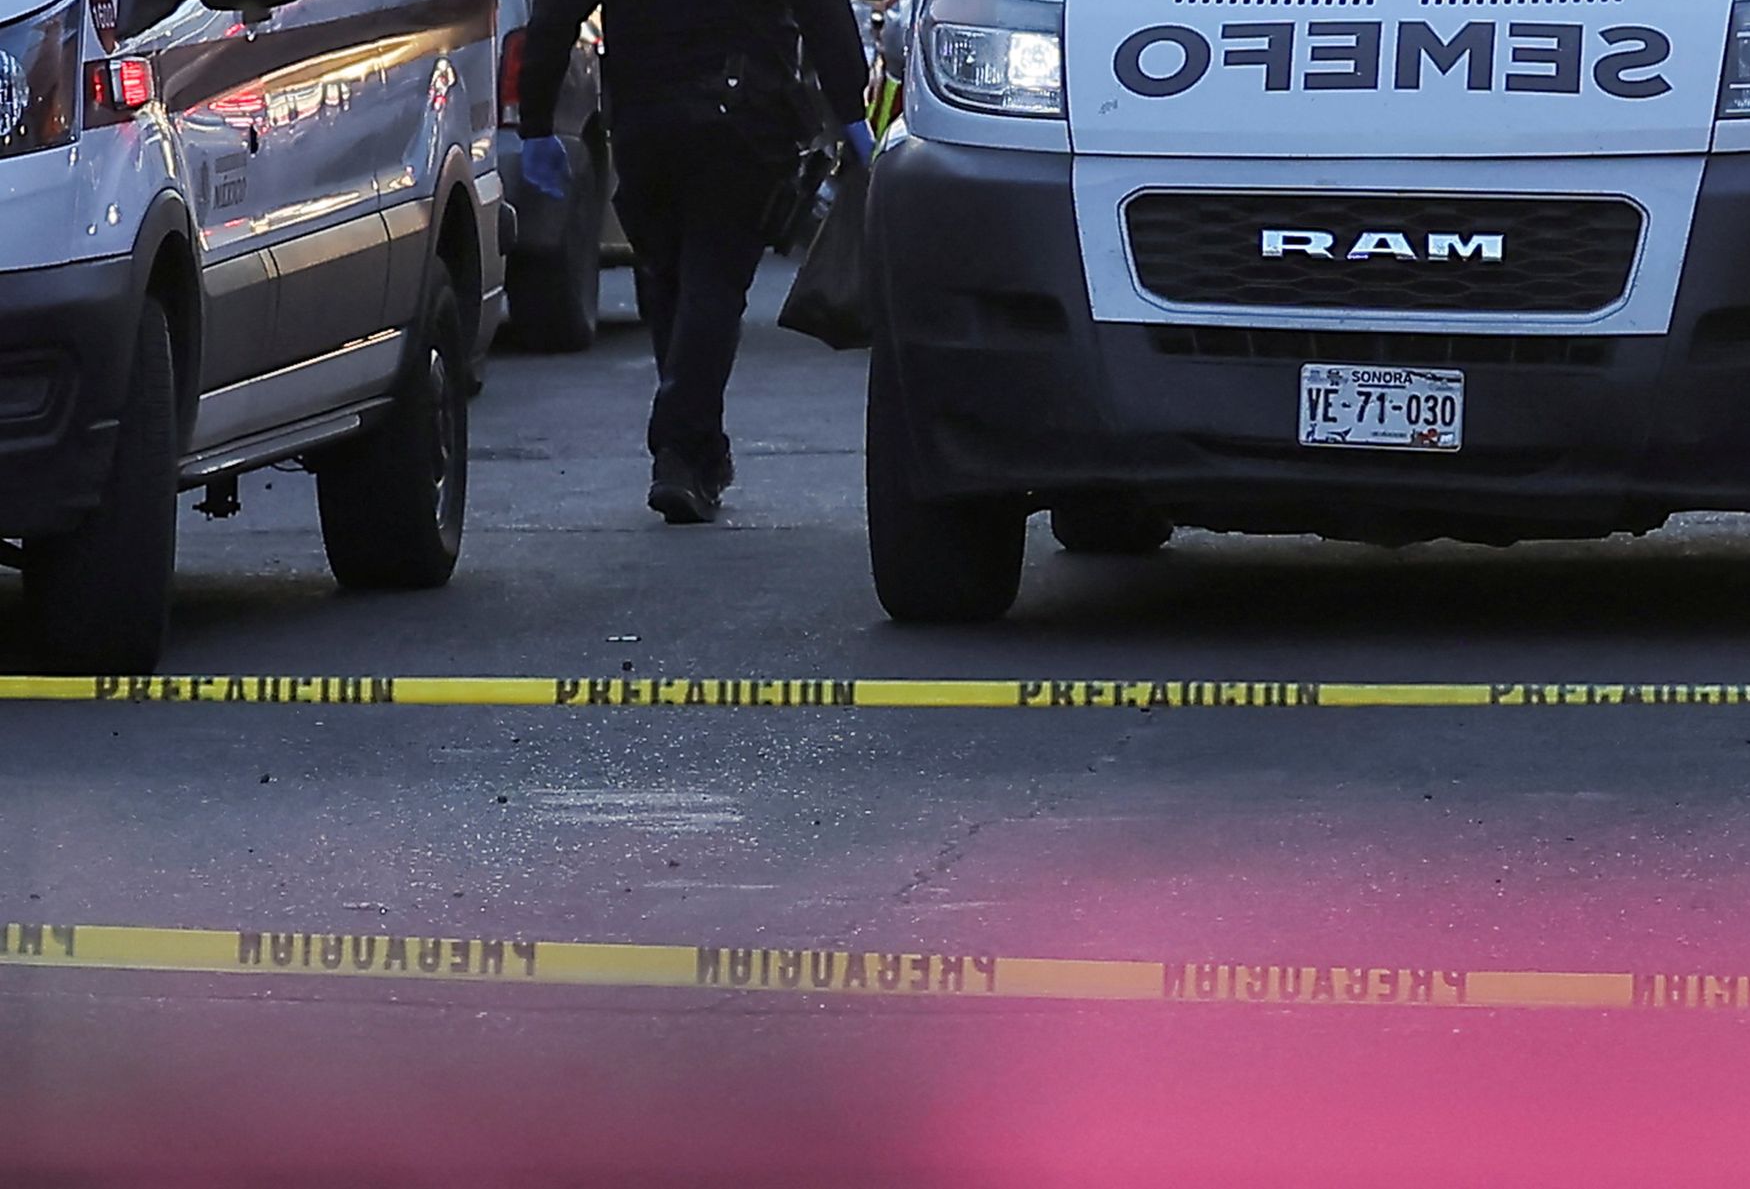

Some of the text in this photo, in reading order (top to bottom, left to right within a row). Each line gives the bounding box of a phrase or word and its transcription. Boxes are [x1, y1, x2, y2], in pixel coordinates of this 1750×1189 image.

[1259, 227, 1507, 261] RAM
[1352, 370, 1413, 385] SONORA
[1307, 387, 1456, 426] VE-71-030
